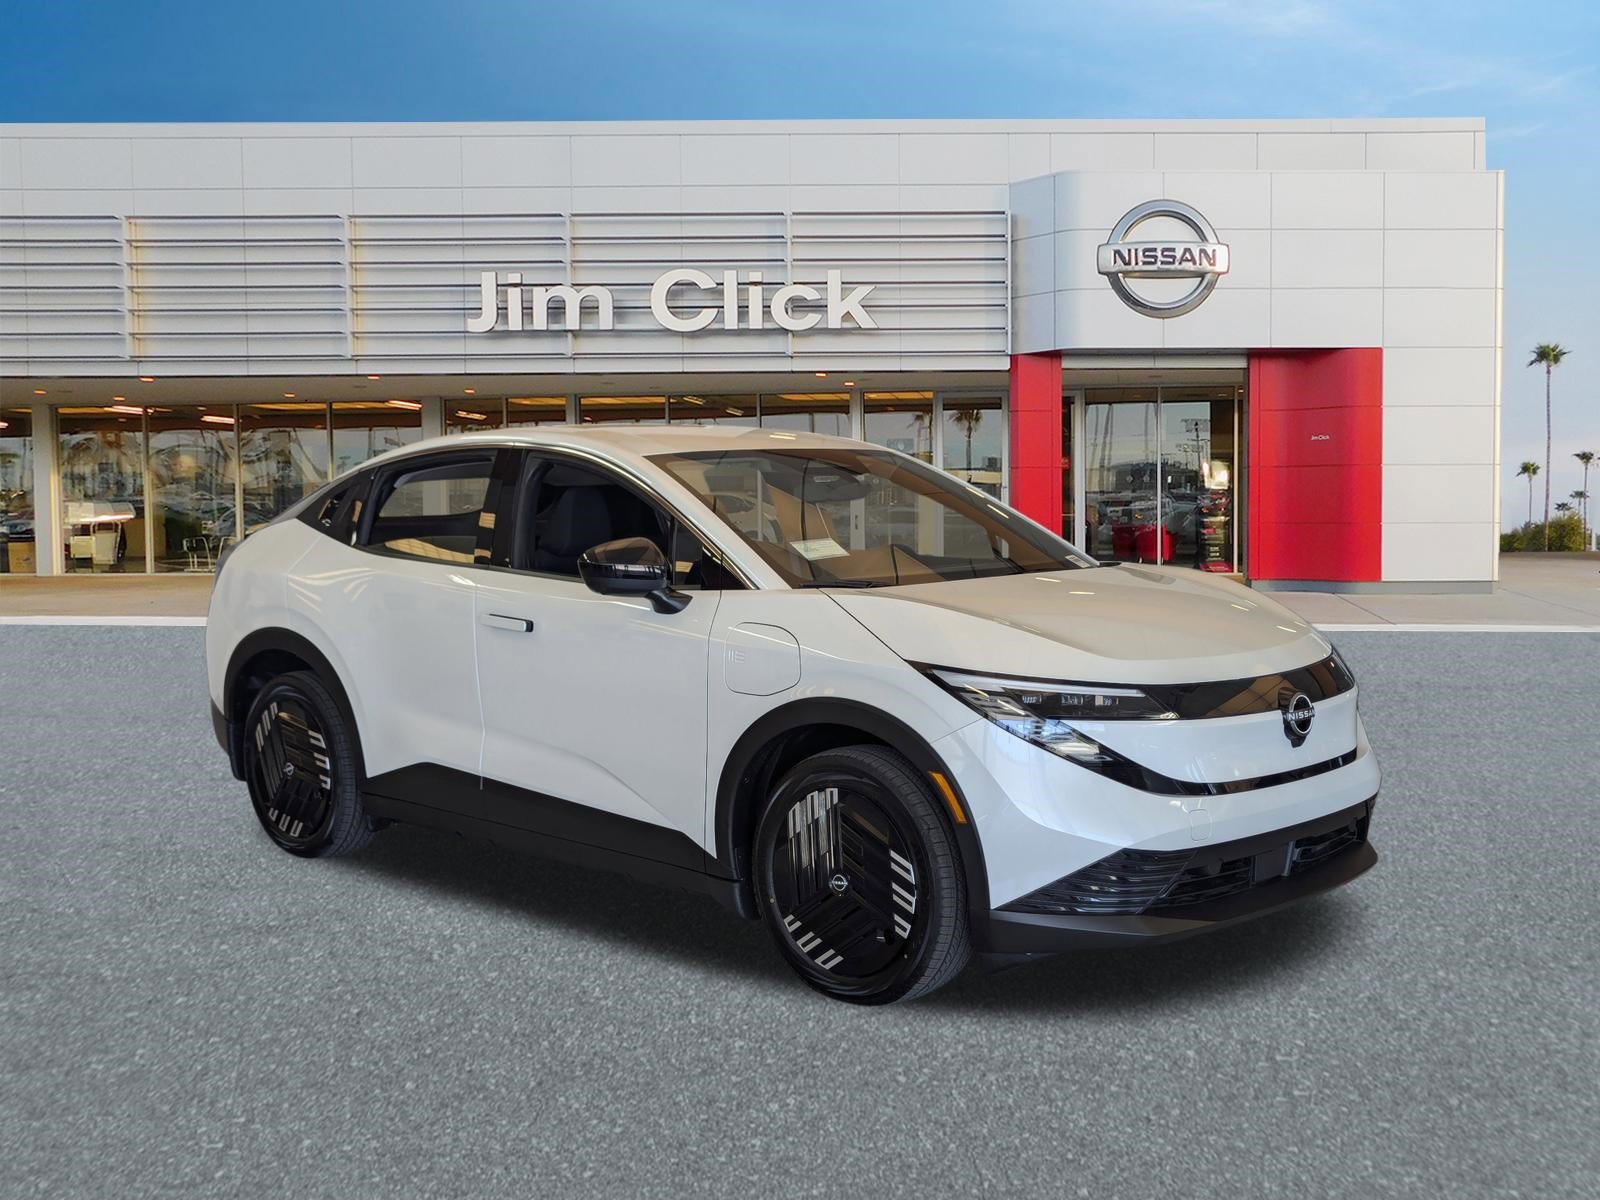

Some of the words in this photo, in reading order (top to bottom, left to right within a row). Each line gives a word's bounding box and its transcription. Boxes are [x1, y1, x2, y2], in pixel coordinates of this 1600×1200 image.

[1112, 247, 1217, 267] NISSAN
[467, 271, 614, 333] Jim
[650, 268, 879, 333] Click
[1288, 710, 1314, 721] NISSA
